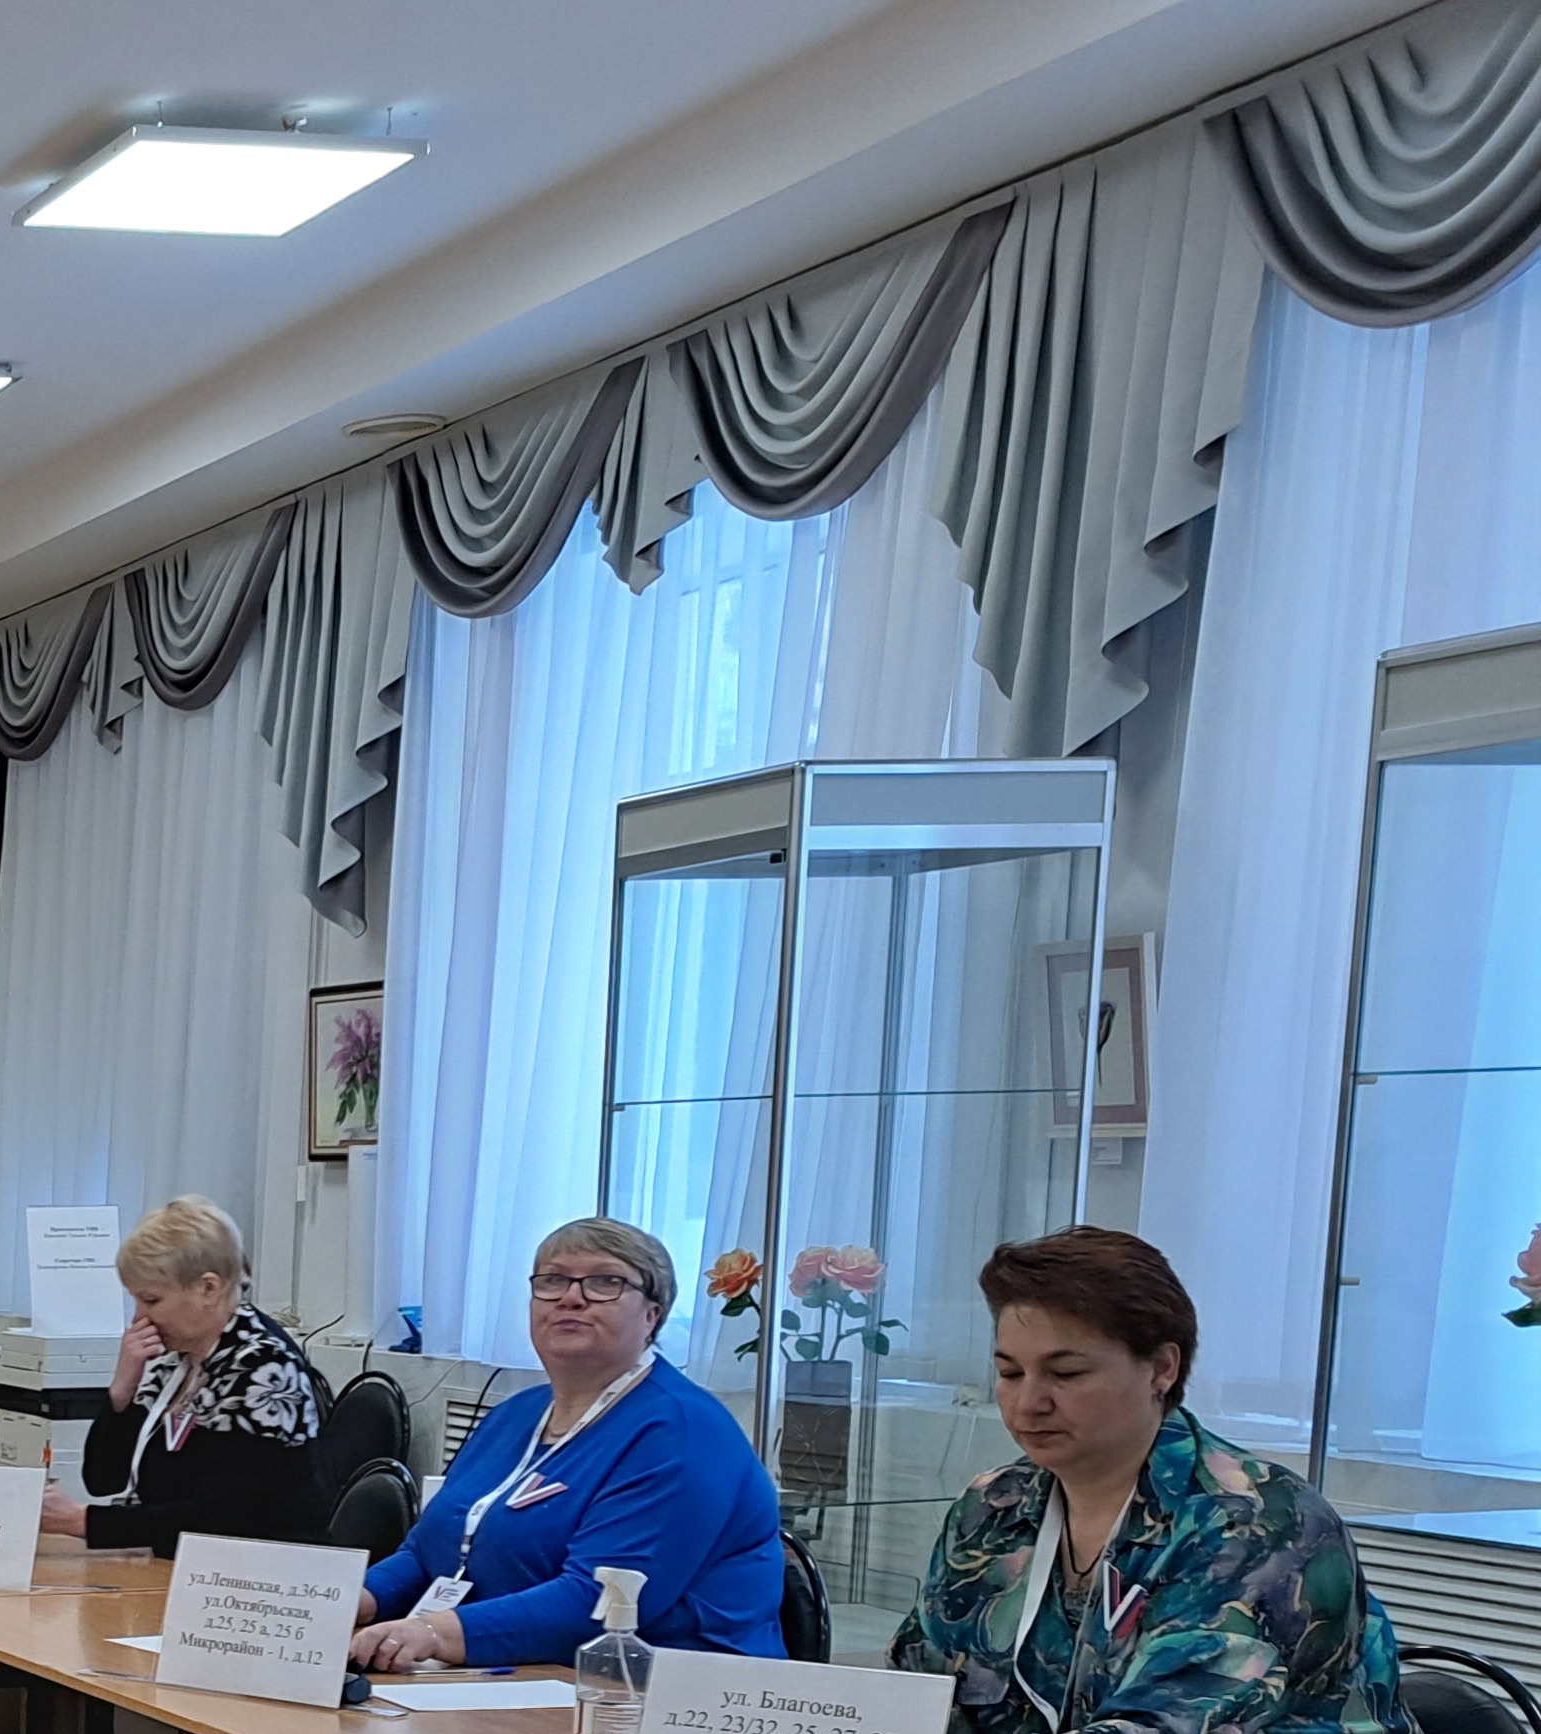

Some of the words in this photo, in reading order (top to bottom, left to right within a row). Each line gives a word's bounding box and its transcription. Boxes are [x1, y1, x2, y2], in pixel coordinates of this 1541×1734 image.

[187, 1572, 284, 1596] ул.Ленинская,
[286, 1583, 341, 1602] д.36-40
[203, 1595, 314, 1622] ул.Октябрьская,
[204, 1616, 236, 1633] д.25,
[239, 1619, 257, 1634] 25
[260, 1627, 271, 1638] а,
[274, 1624, 292, 1639] 25
[179, 1631, 264, 1657] Микрорайон
[278, 1646, 289, 1663] 1,
[292, 1650, 324, 1666] д.12
[663, 1709, 714, 1732] д.22,
[720, 1690, 751, 1708] ул.
[759, 1690, 863, 1723] Благоева,
